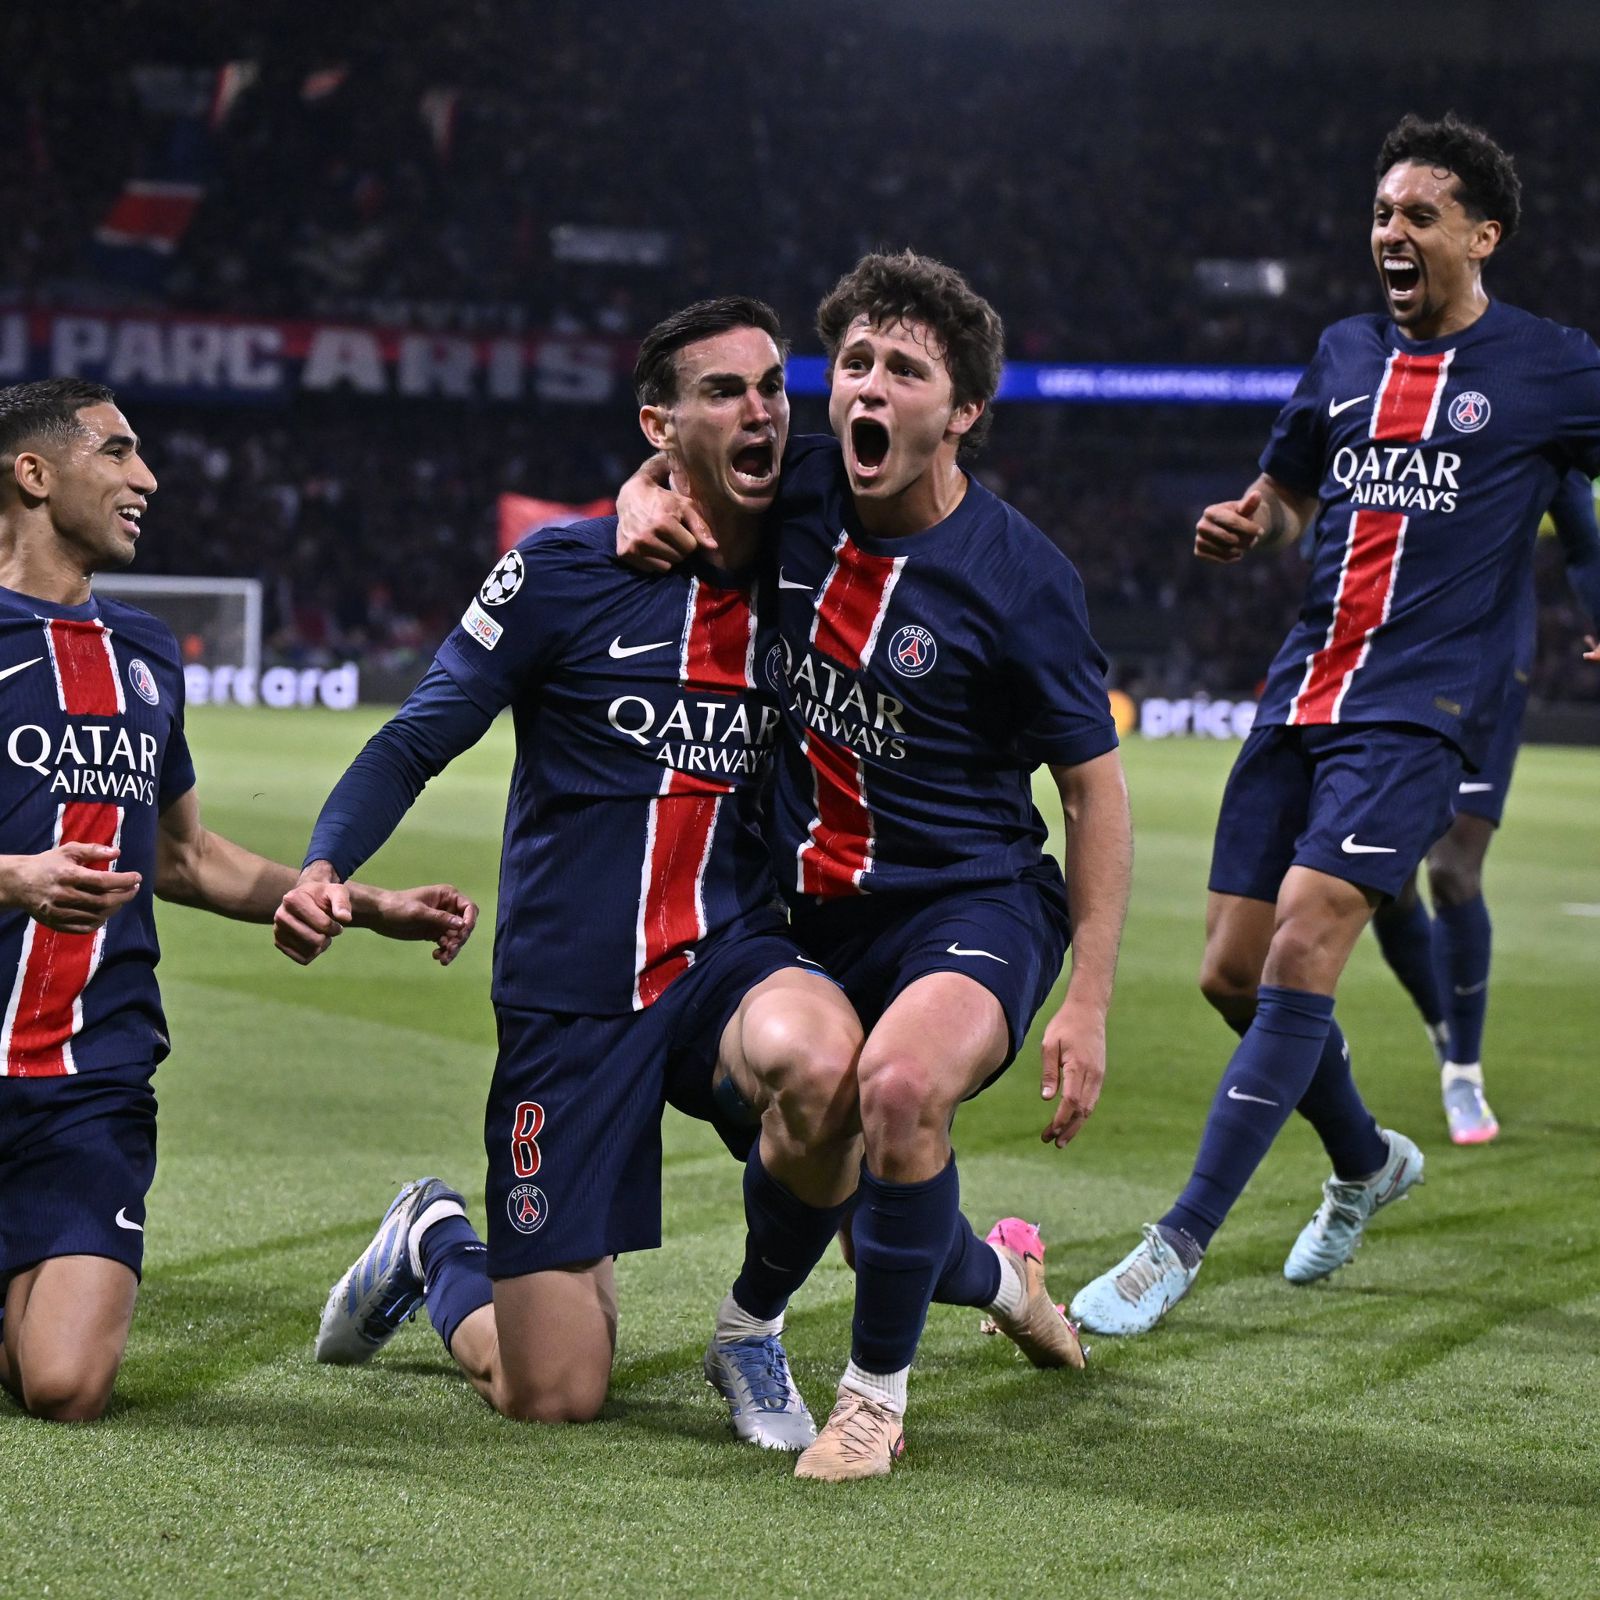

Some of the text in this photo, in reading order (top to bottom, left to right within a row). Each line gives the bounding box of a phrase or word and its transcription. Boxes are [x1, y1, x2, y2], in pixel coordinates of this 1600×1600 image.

[52, 315, 281, 388] PARC
[1459, 394, 1486, 406] PARIS
[1333, 447, 1461, 489] QATAR
[1350, 482, 1458, 513] AIRWAYS
[902, 628, 932, 646] PARIS
[607, 695, 780, 745] QATAR
[789, 692, 906, 760] AIRWAYS
[7, 724, 157, 777] QATAR
[50, 769, 154, 806] AIRWAYS
[511, 1101, 545, 1179] 8
[511, 1186, 538, 1200] PARIS
